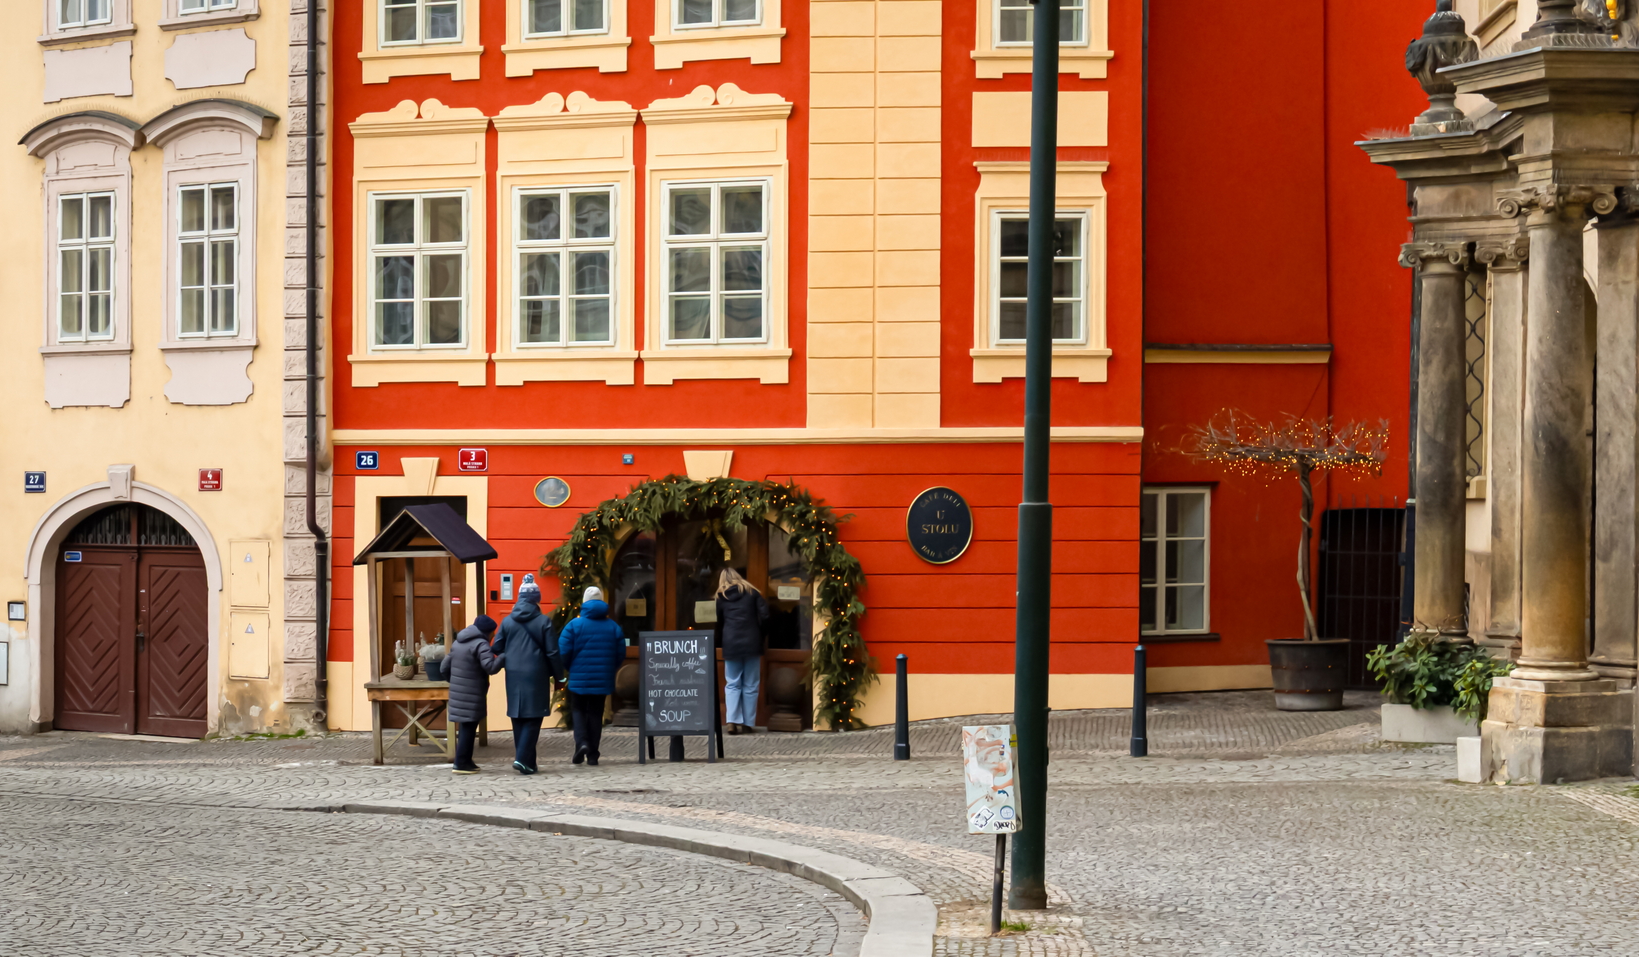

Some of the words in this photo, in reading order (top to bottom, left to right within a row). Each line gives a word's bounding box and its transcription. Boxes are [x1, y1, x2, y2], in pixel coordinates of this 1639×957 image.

[360, 455, 374, 466] 26
[470, 451, 476, 461] 3
[29, 475, 40, 484] 27
[207, 470, 213, 480] 4
[943, 493, 961, 507] DELI
[922, 524, 959, 534] STOLU
[654, 640, 698, 654] BRUNCH
[681, 657, 702, 670] coffee
[648, 689, 662, 698] HOT
[664, 688, 698, 698] CHOCOLATE
[658, 709, 692, 723] SOUP
